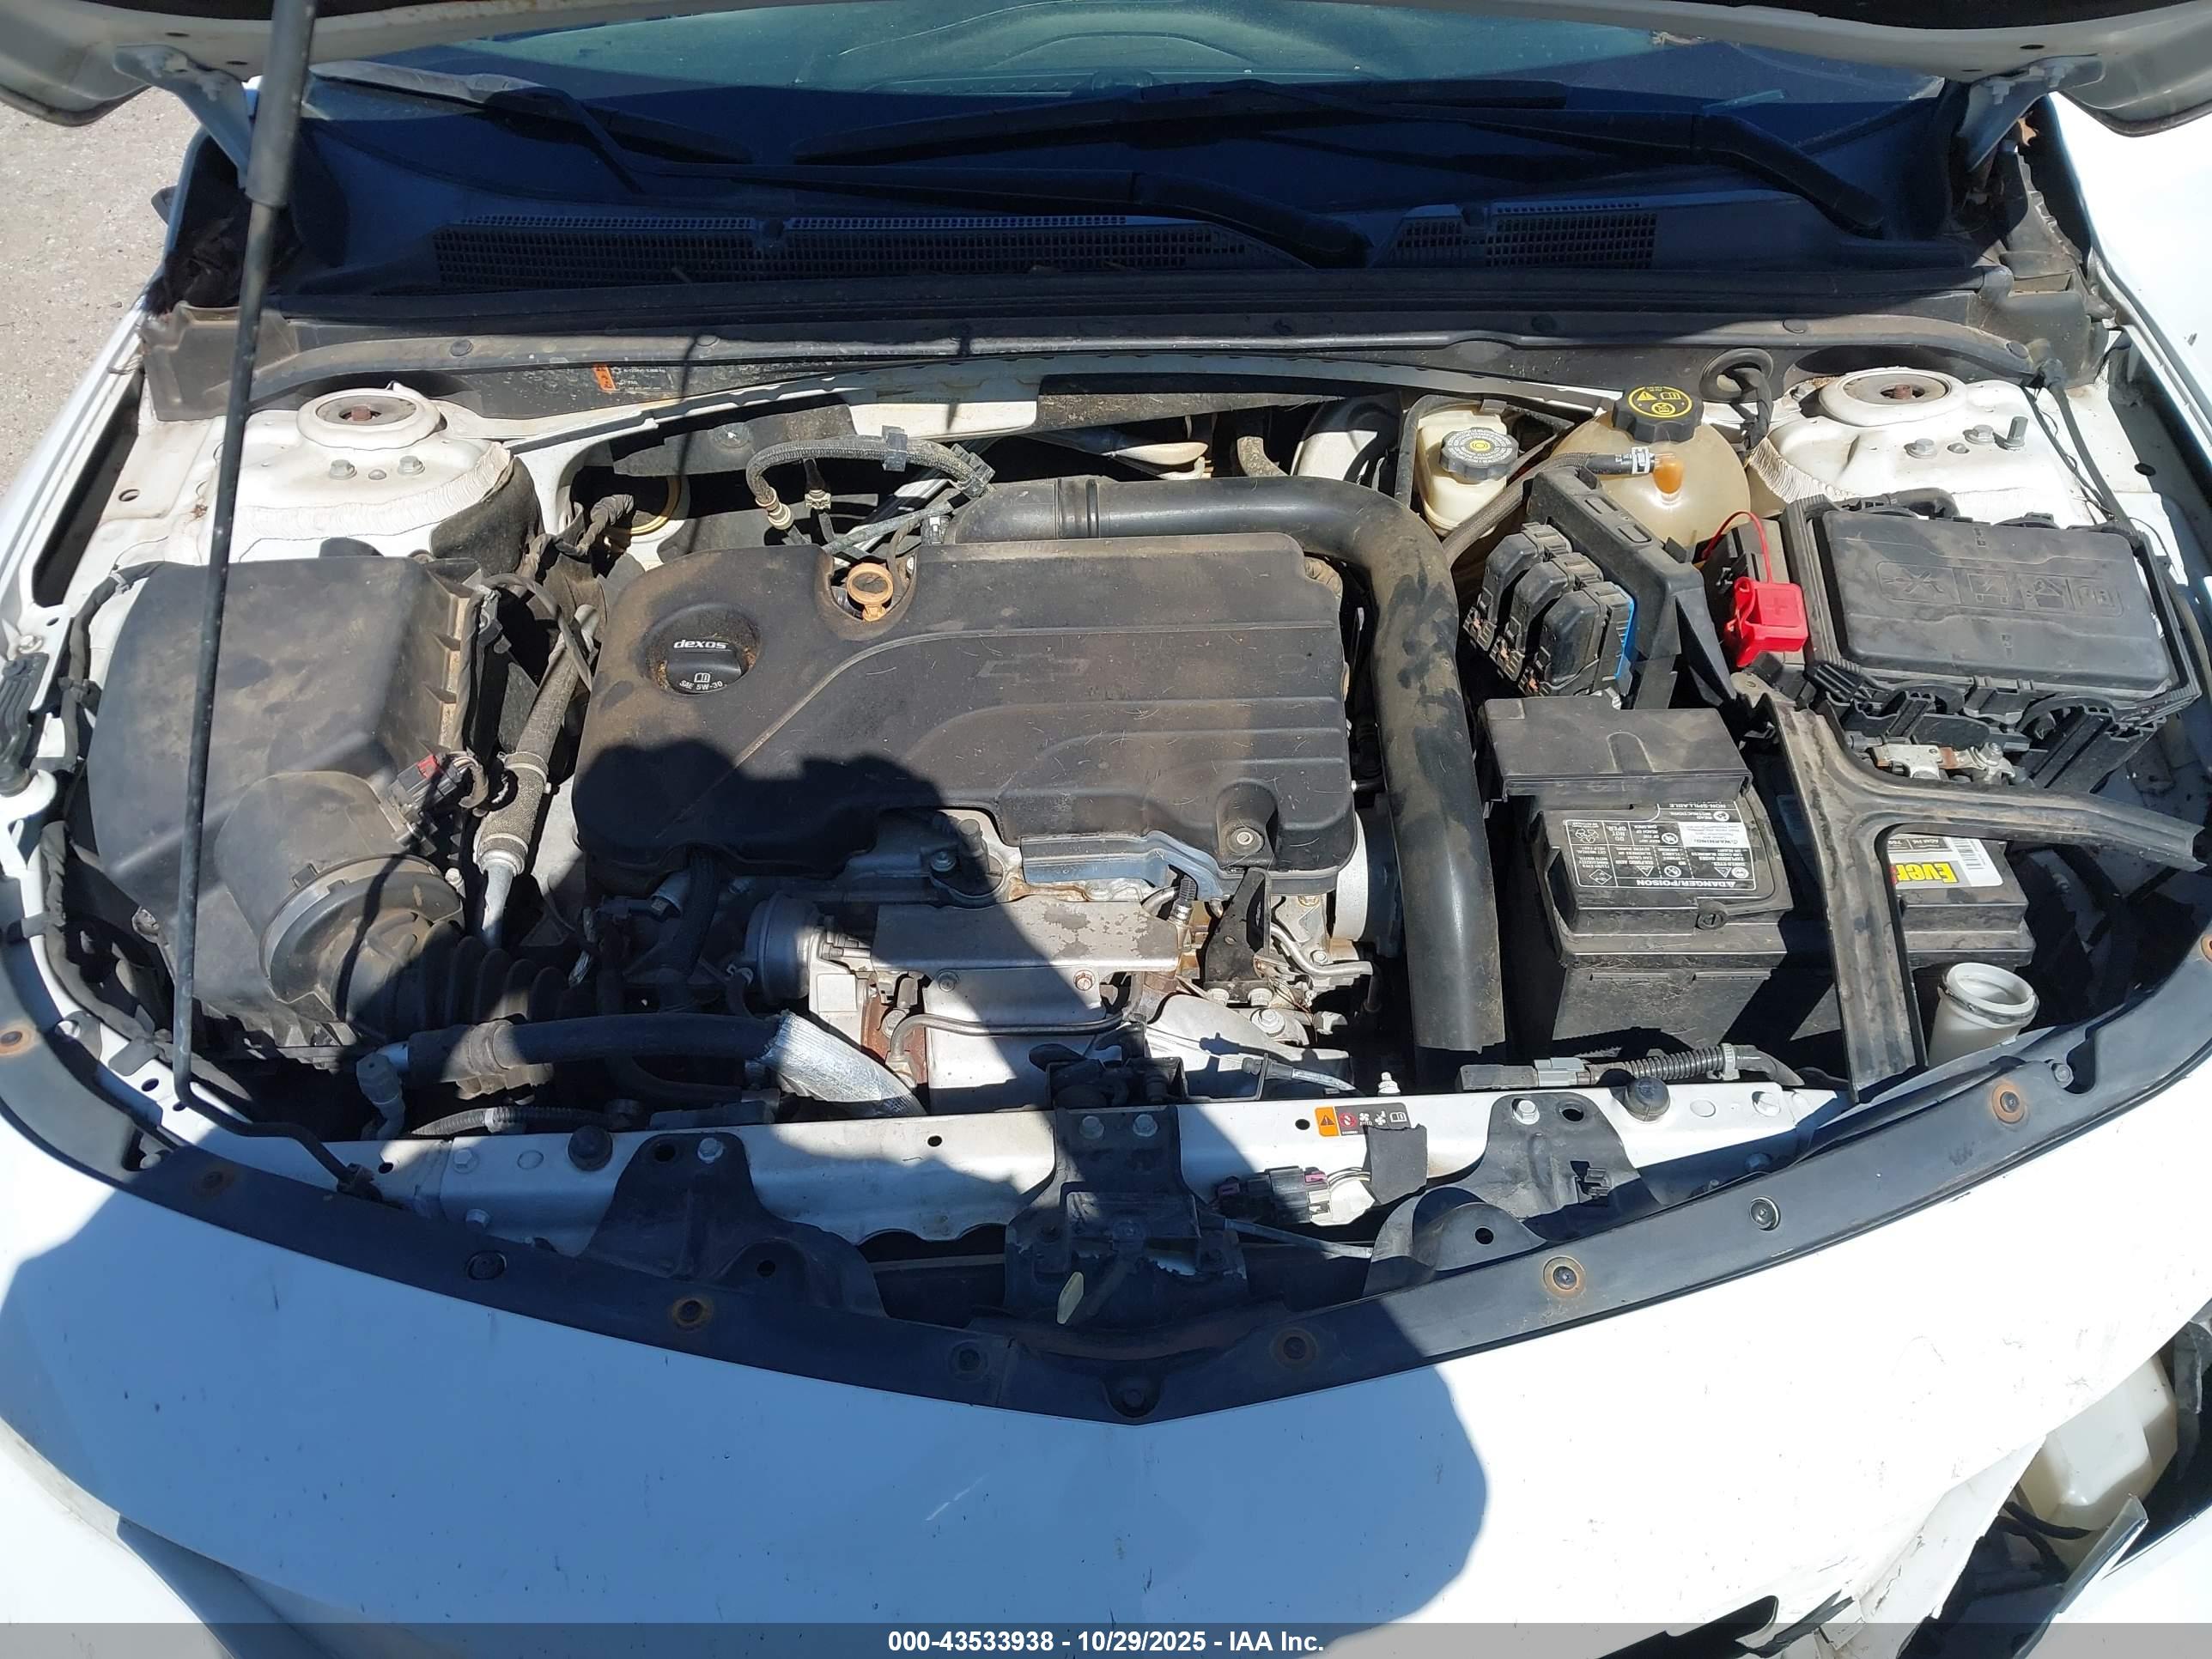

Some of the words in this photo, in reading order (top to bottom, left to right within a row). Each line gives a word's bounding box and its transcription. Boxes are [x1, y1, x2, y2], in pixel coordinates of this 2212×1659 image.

[673, 640, 729, 649] dexos
[679, 680, 694, 690] SAE
[696, 681, 723, 690] 5W-30
